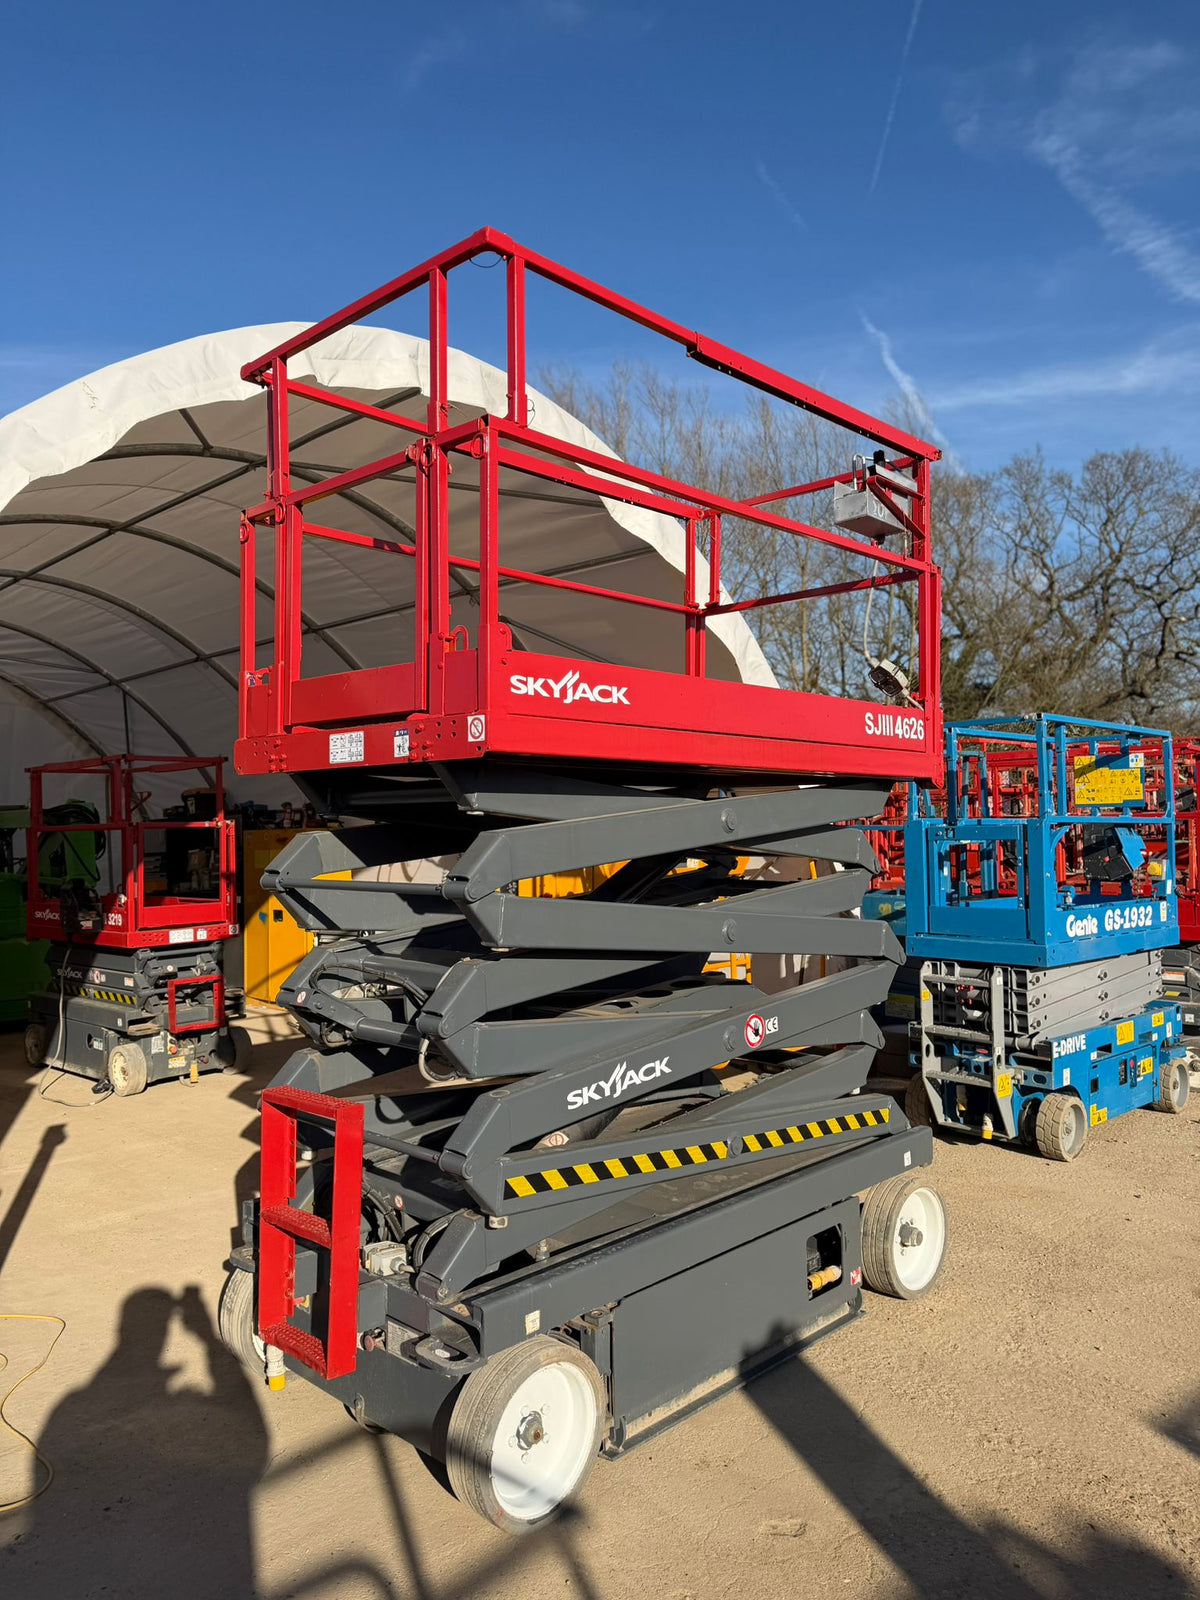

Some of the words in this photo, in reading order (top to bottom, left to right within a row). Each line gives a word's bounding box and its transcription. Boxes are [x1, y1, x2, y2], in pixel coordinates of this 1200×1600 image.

[510, 669, 631, 705] SKYJACK
[895, 715, 925, 741] 4626
[34, 908, 60, 920] SKYJACK
[107, 913, 123, 926] 3219
[1066, 913, 1098, 938] Genie
[1105, 905, 1153, 931] GS-1932
[767, 1017, 777, 1032] CE
[1053, 1034, 1087, 1059] E-DRIVE
[567, 1056, 673, 1110] SKYJACK
